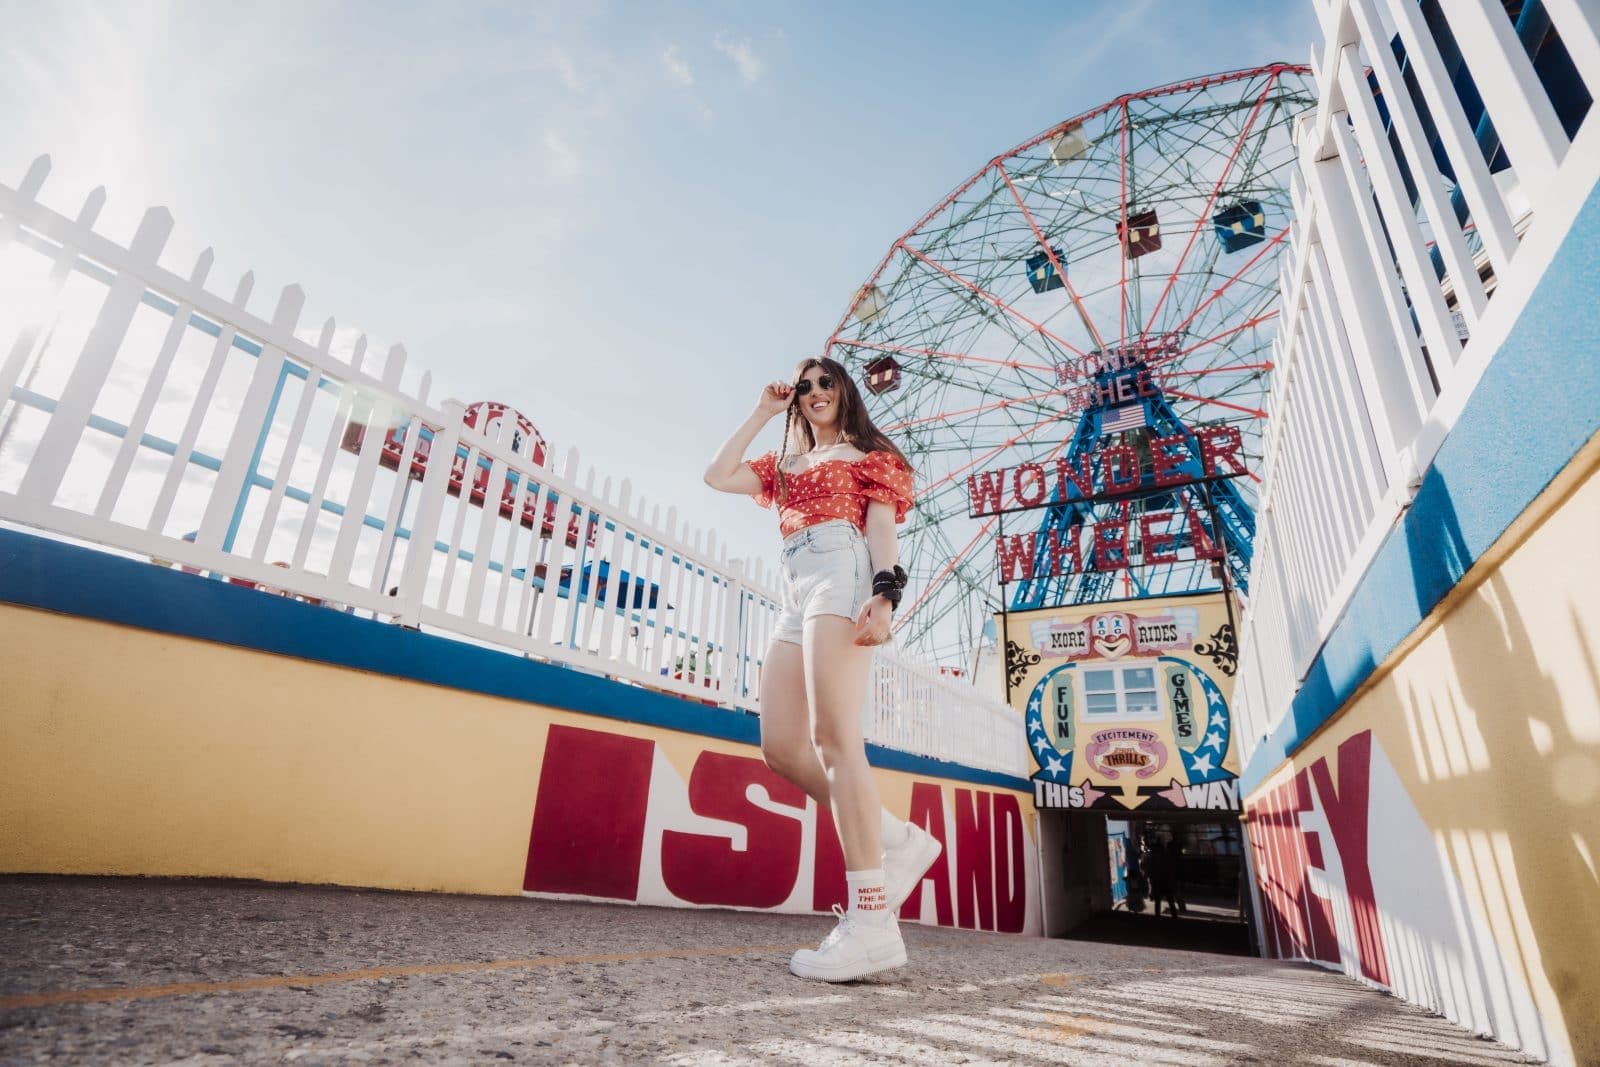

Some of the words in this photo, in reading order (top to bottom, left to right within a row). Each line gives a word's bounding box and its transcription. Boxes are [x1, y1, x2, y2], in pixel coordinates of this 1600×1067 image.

[1055, 331, 1180, 384] WONDER
[1066, 366, 1178, 412] WHEEL
[967, 425, 1247, 515] WONDER
[996, 508, 1223, 582] WHEEL
[1052, 630, 1085, 648] MORE
[1138, 624, 1178, 643] RIDES
[1057, 687, 1069, 738] FUN
[1171, 673, 1192, 737] GAMES
[1096, 731, 1154, 743] EXCITEMENT
[1104, 752, 1147, 766] THRILLS
[1033, 778, 1084, 808] THIS
[1183, 778, 1240, 810] WAY
